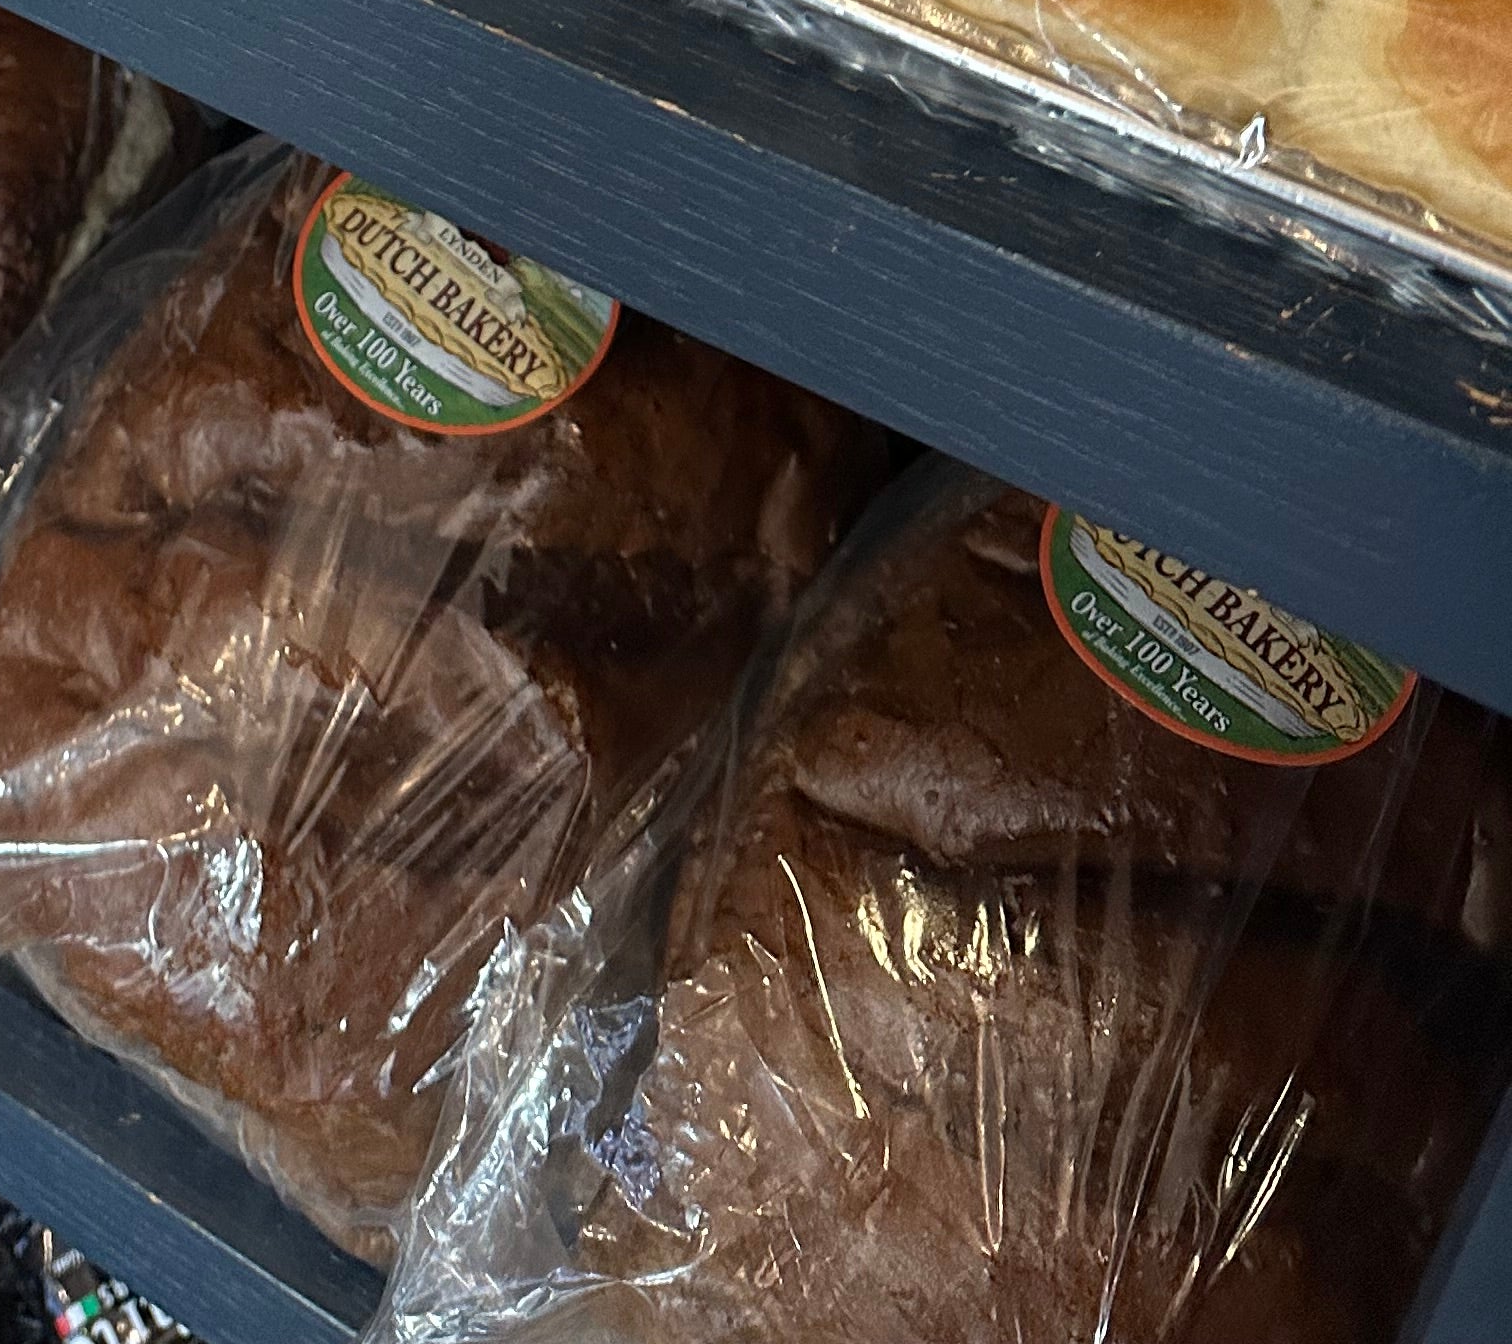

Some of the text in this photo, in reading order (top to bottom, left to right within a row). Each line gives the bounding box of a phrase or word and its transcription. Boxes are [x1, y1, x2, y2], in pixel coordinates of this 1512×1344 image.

[339, 208, 441, 295] DUTCH
[430, 278, 549, 379] BAKERY
[439, 226, 503, 285] LYNDEN
[314, 291, 357, 335] Over
[357, 328, 398, 369] 100
[394, 358, 442, 415] Years
[1071, 592, 1232, 733] Over 100 Years
[1206, 586, 1347, 714] BAKERY
